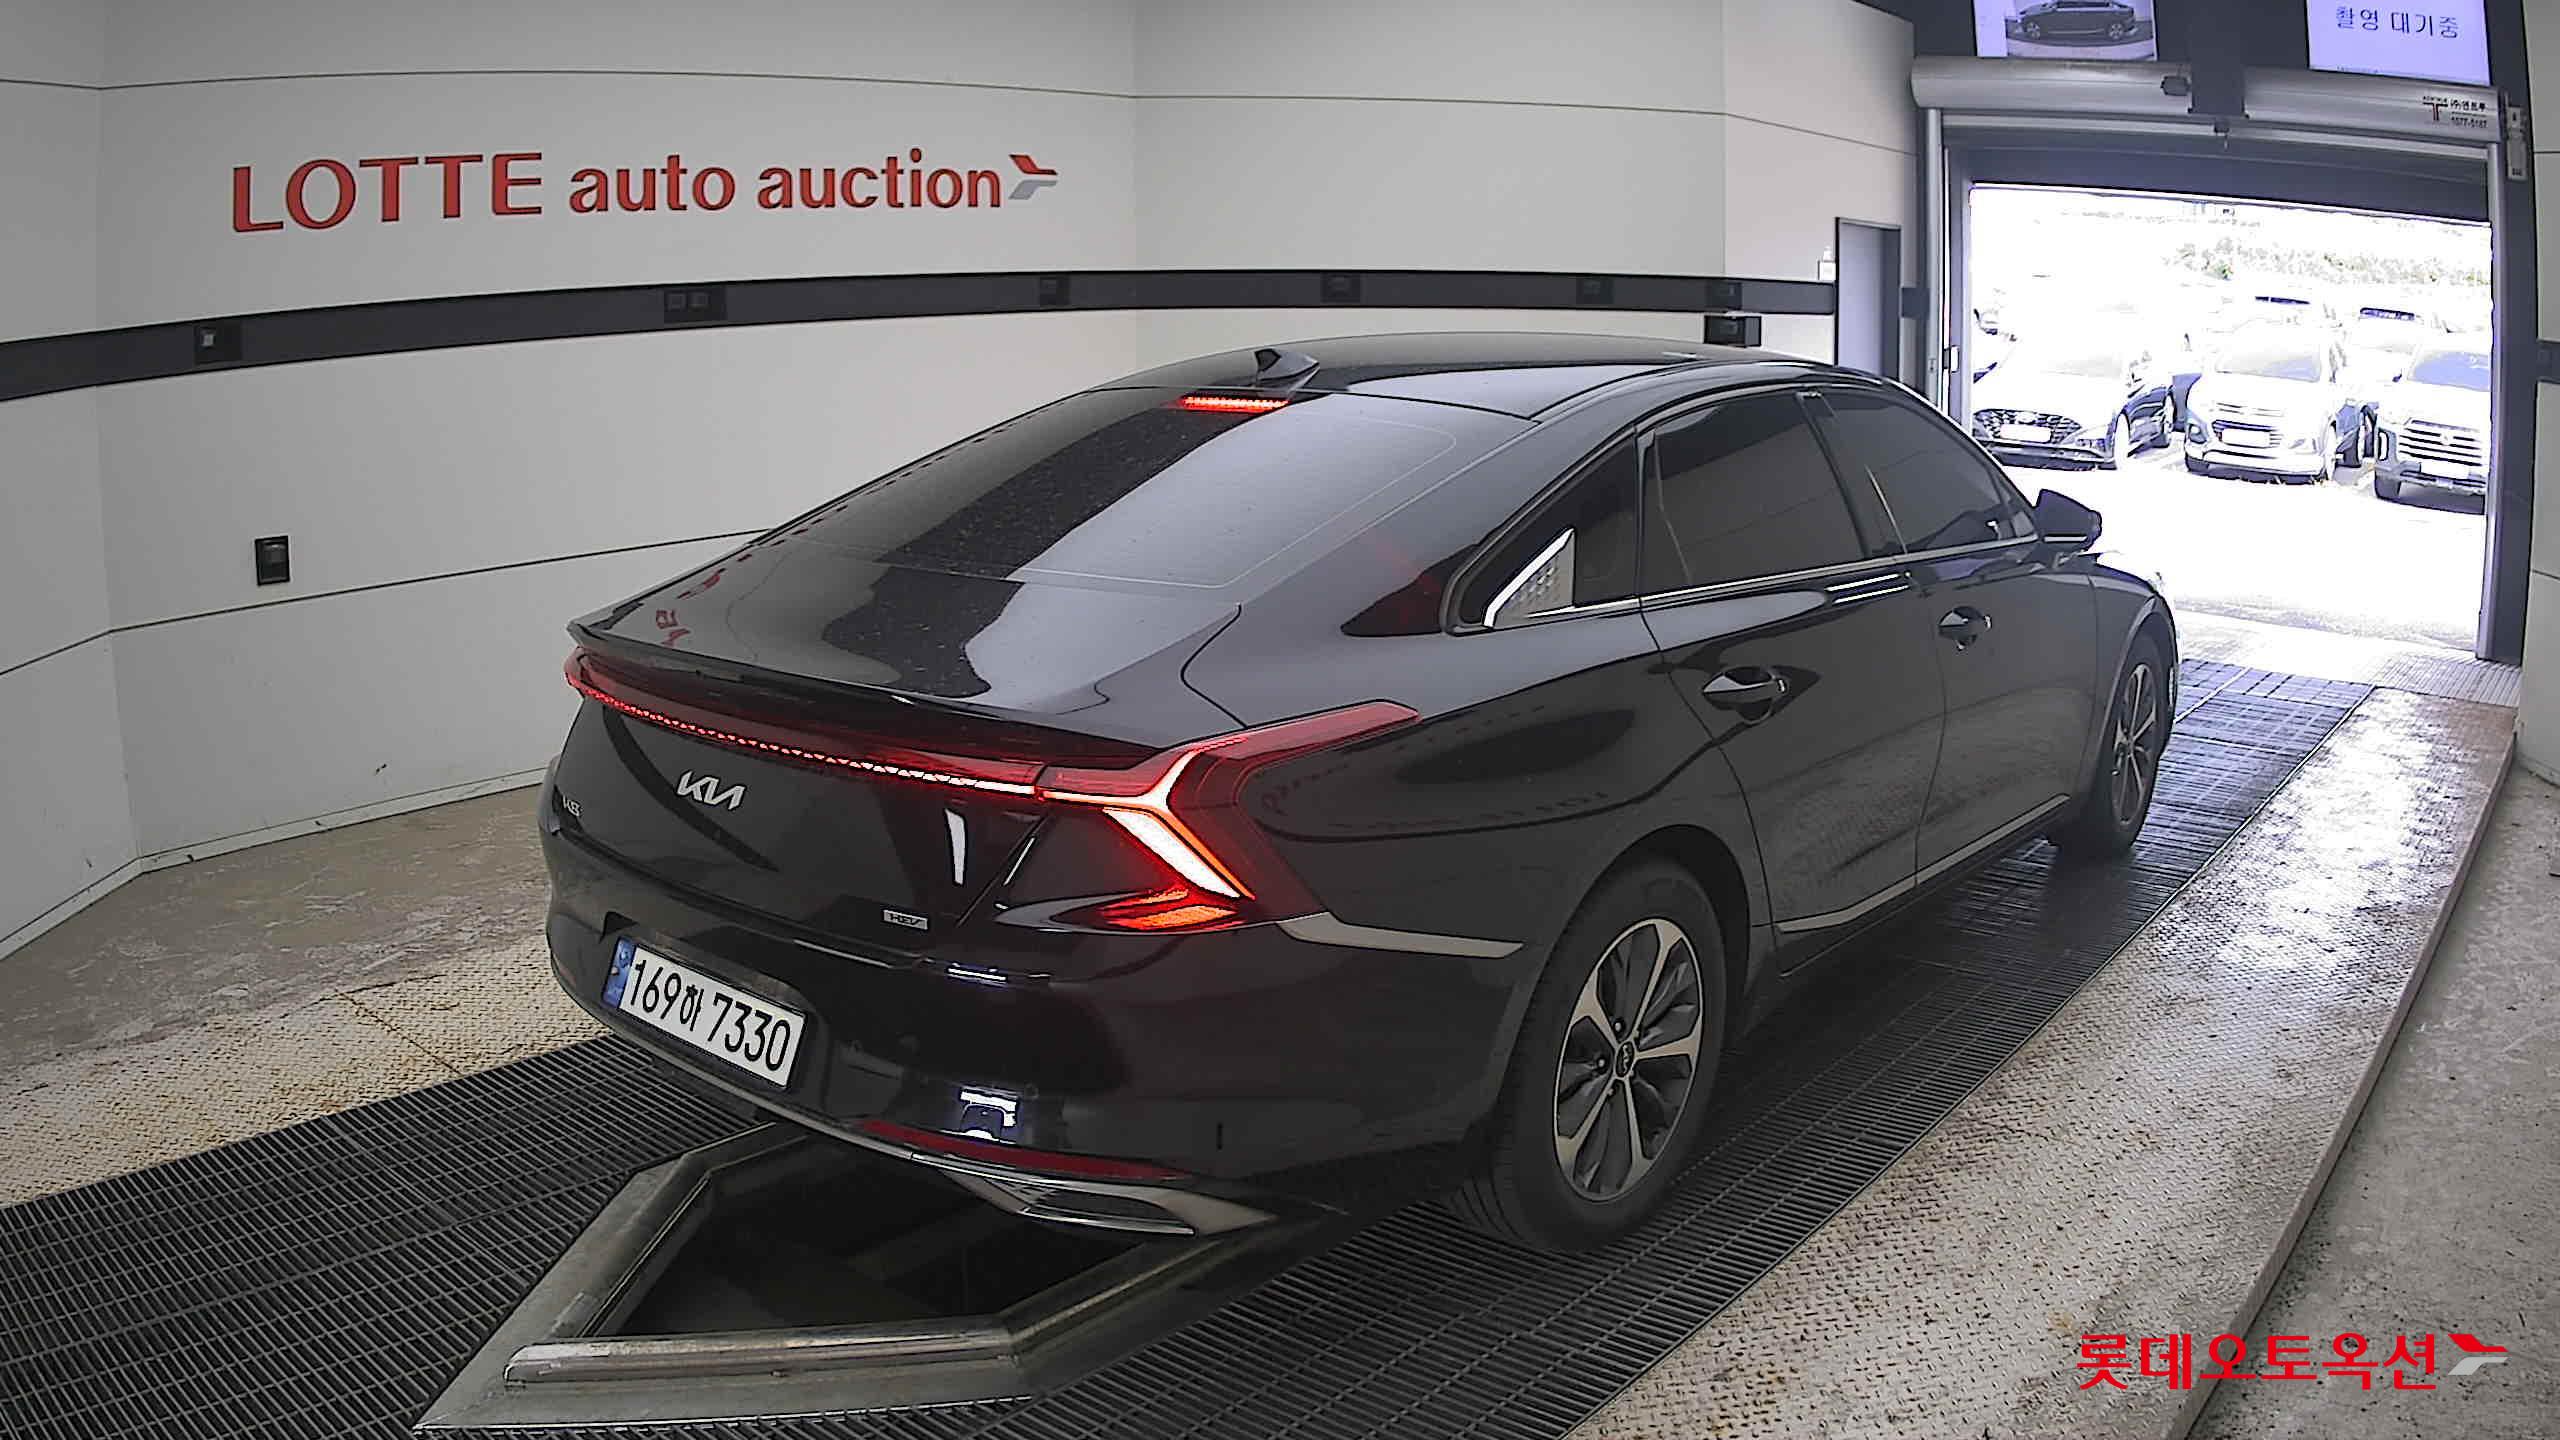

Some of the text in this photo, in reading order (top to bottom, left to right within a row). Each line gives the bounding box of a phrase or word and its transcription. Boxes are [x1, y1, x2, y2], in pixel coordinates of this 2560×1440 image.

[2336, 6, 2460, 39] 촬영 대기중
[232, 147, 1001, 233] LOTTE auto auction
[677, 770, 745, 810] KIA
[630, 959, 791, 1072] 169하 7330
